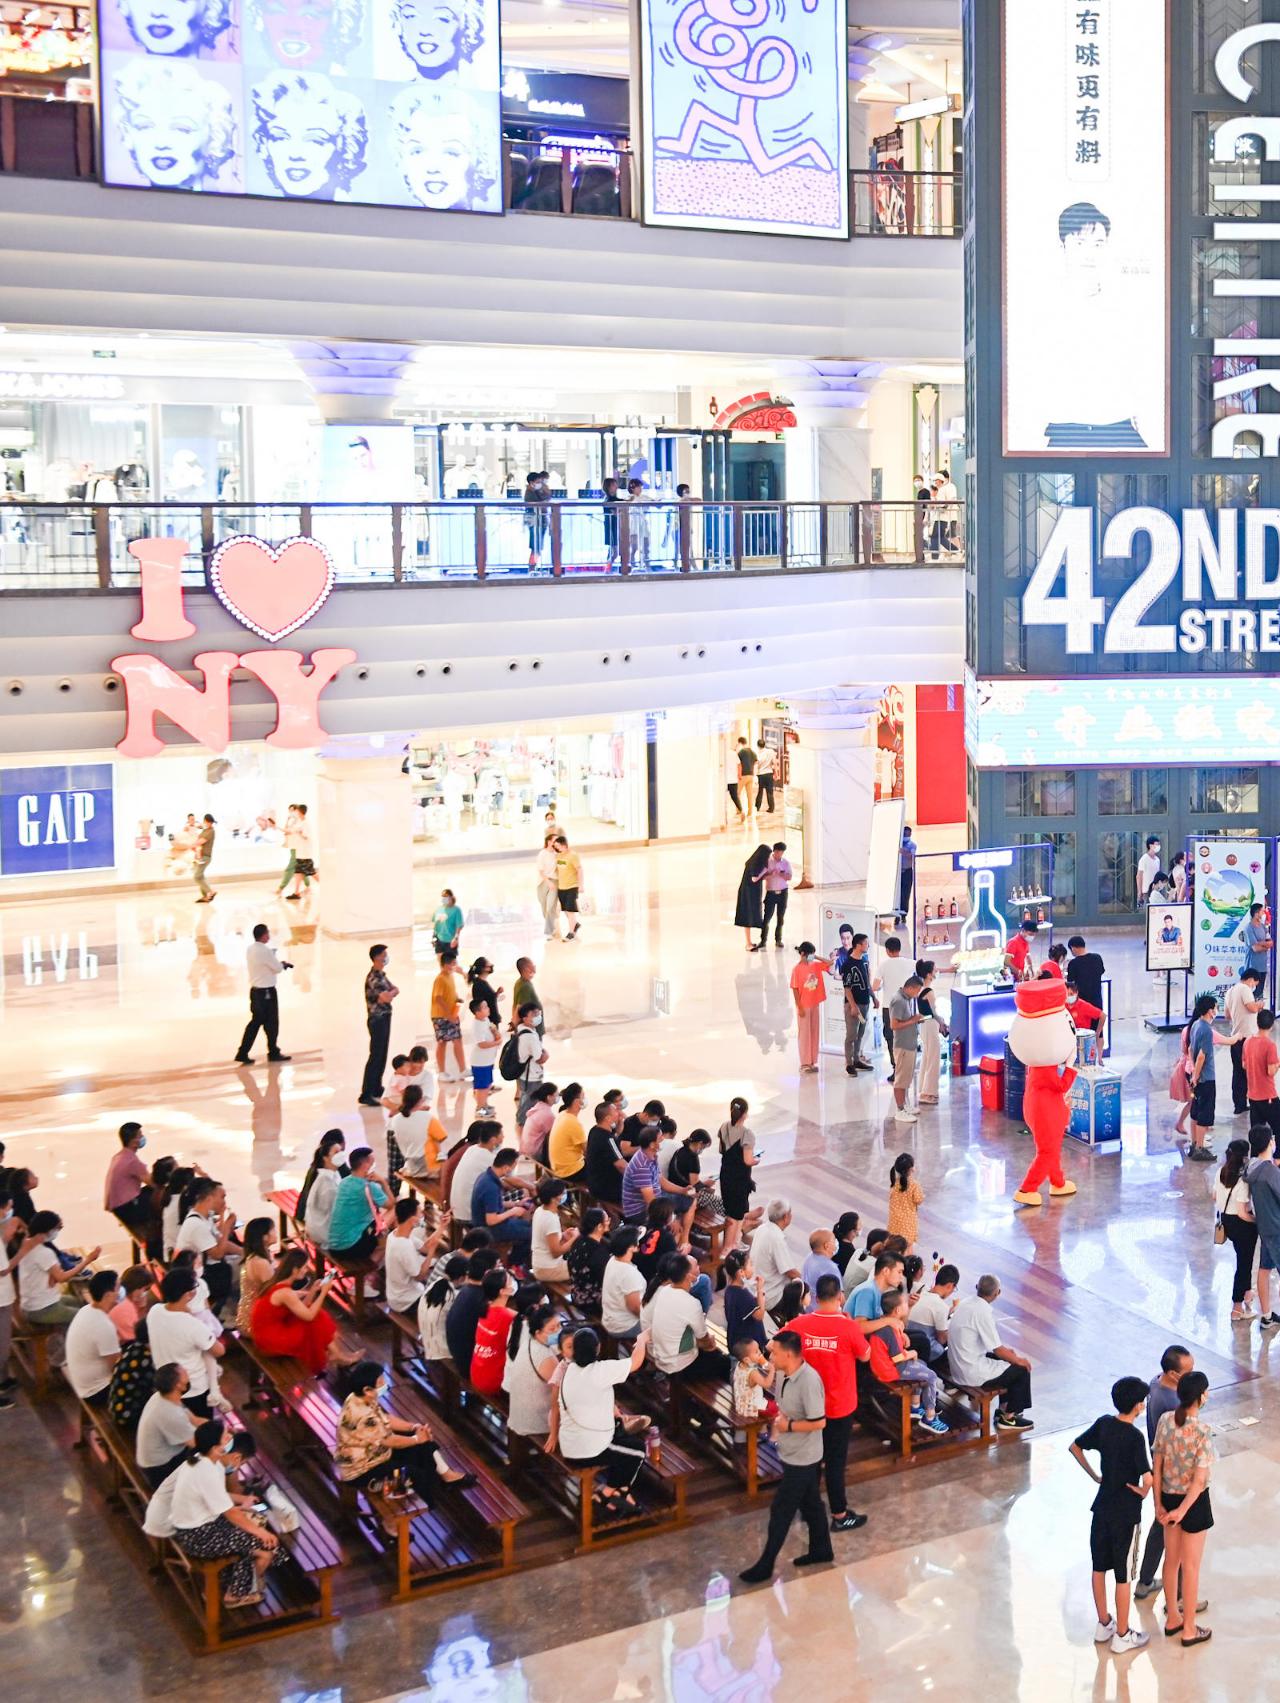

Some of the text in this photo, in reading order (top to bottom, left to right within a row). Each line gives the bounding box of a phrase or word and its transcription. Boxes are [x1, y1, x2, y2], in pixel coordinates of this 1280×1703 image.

[128, 538, 196, 641] I
[111, 648, 357, 758] NY
[17, 792, 95, 847] GAP
